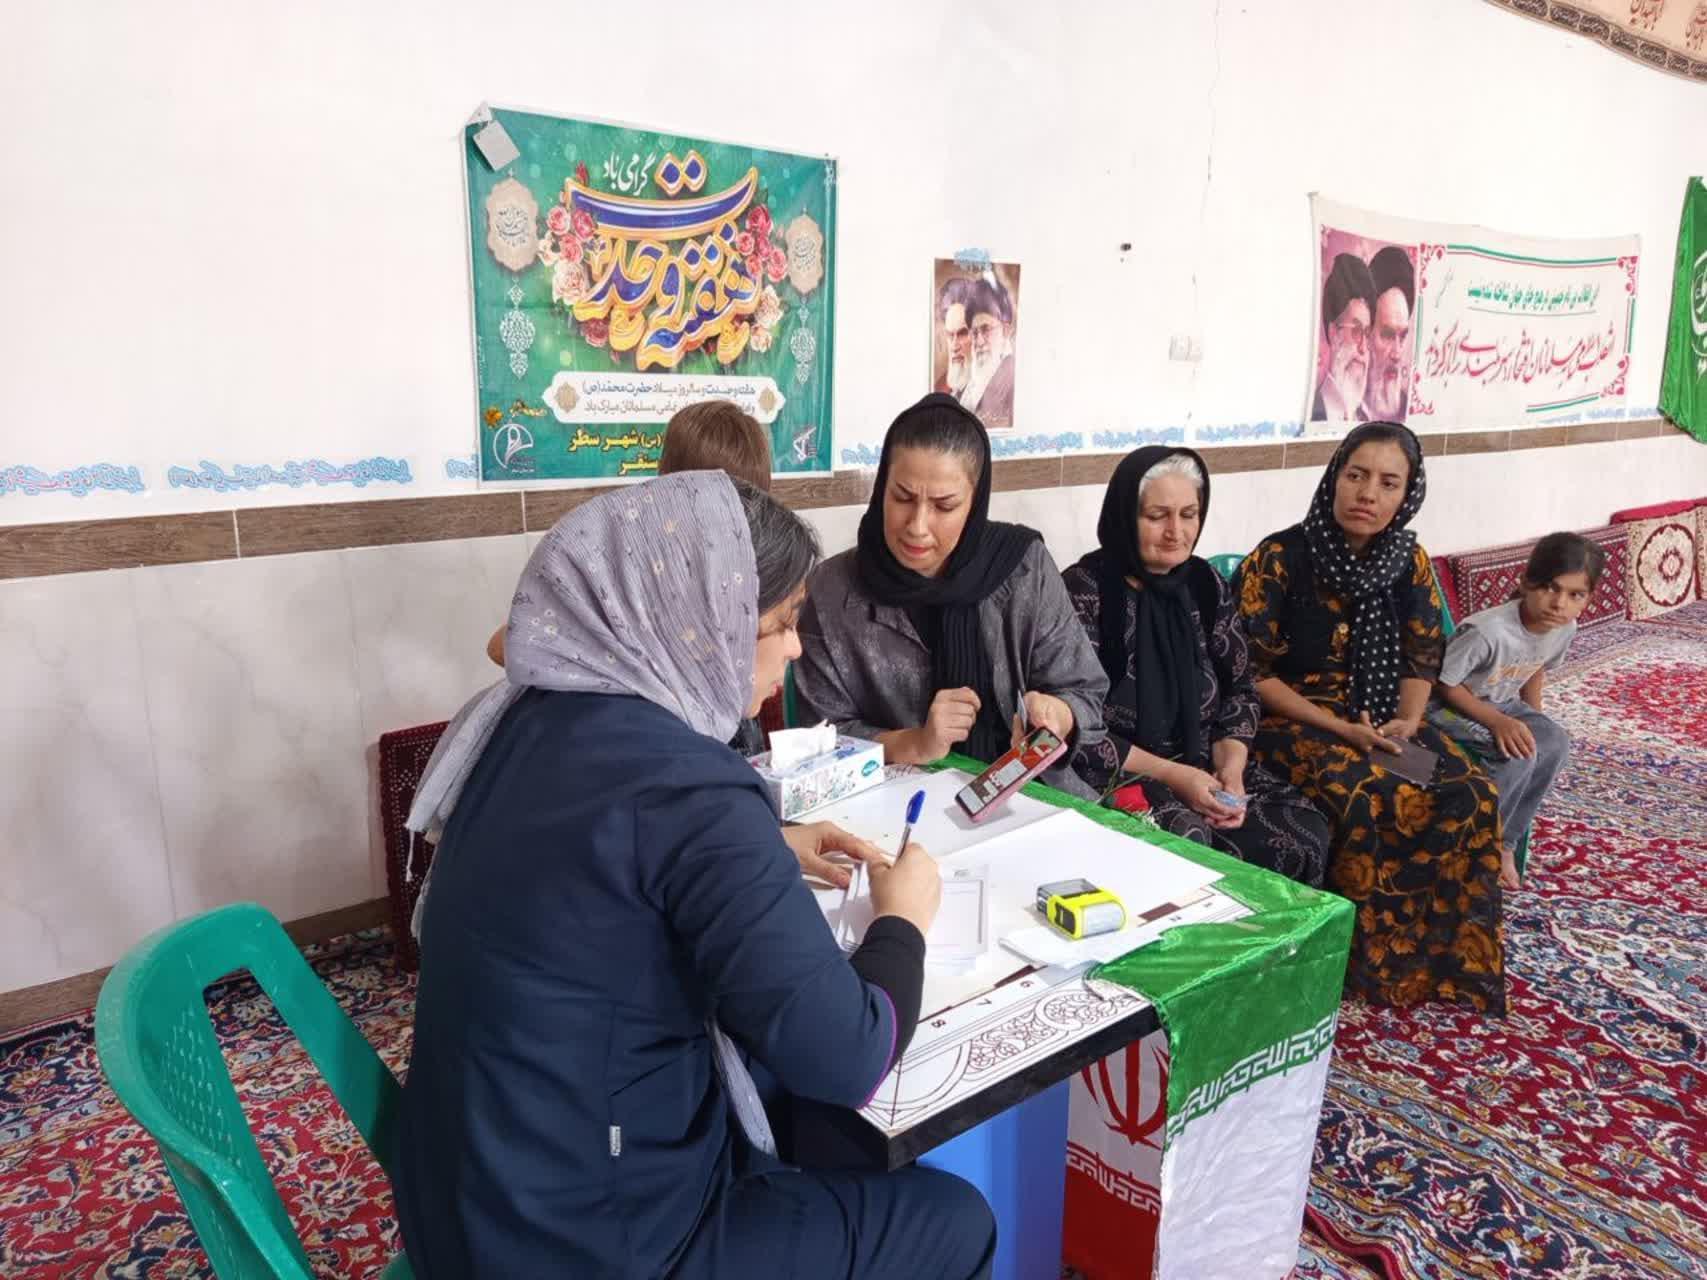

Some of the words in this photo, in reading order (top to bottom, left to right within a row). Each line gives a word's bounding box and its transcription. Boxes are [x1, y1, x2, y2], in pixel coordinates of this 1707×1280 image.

[602, 151, 618, 190] باد
[616, 152, 656, 196] گرامی
[625, 381, 653, 396] حضرت
[584, 399, 597, 414] باد
[597, 399, 620, 414] مبارک
[569, 428, 600, 451] سطر
[603, 428, 639, 450] شهر
